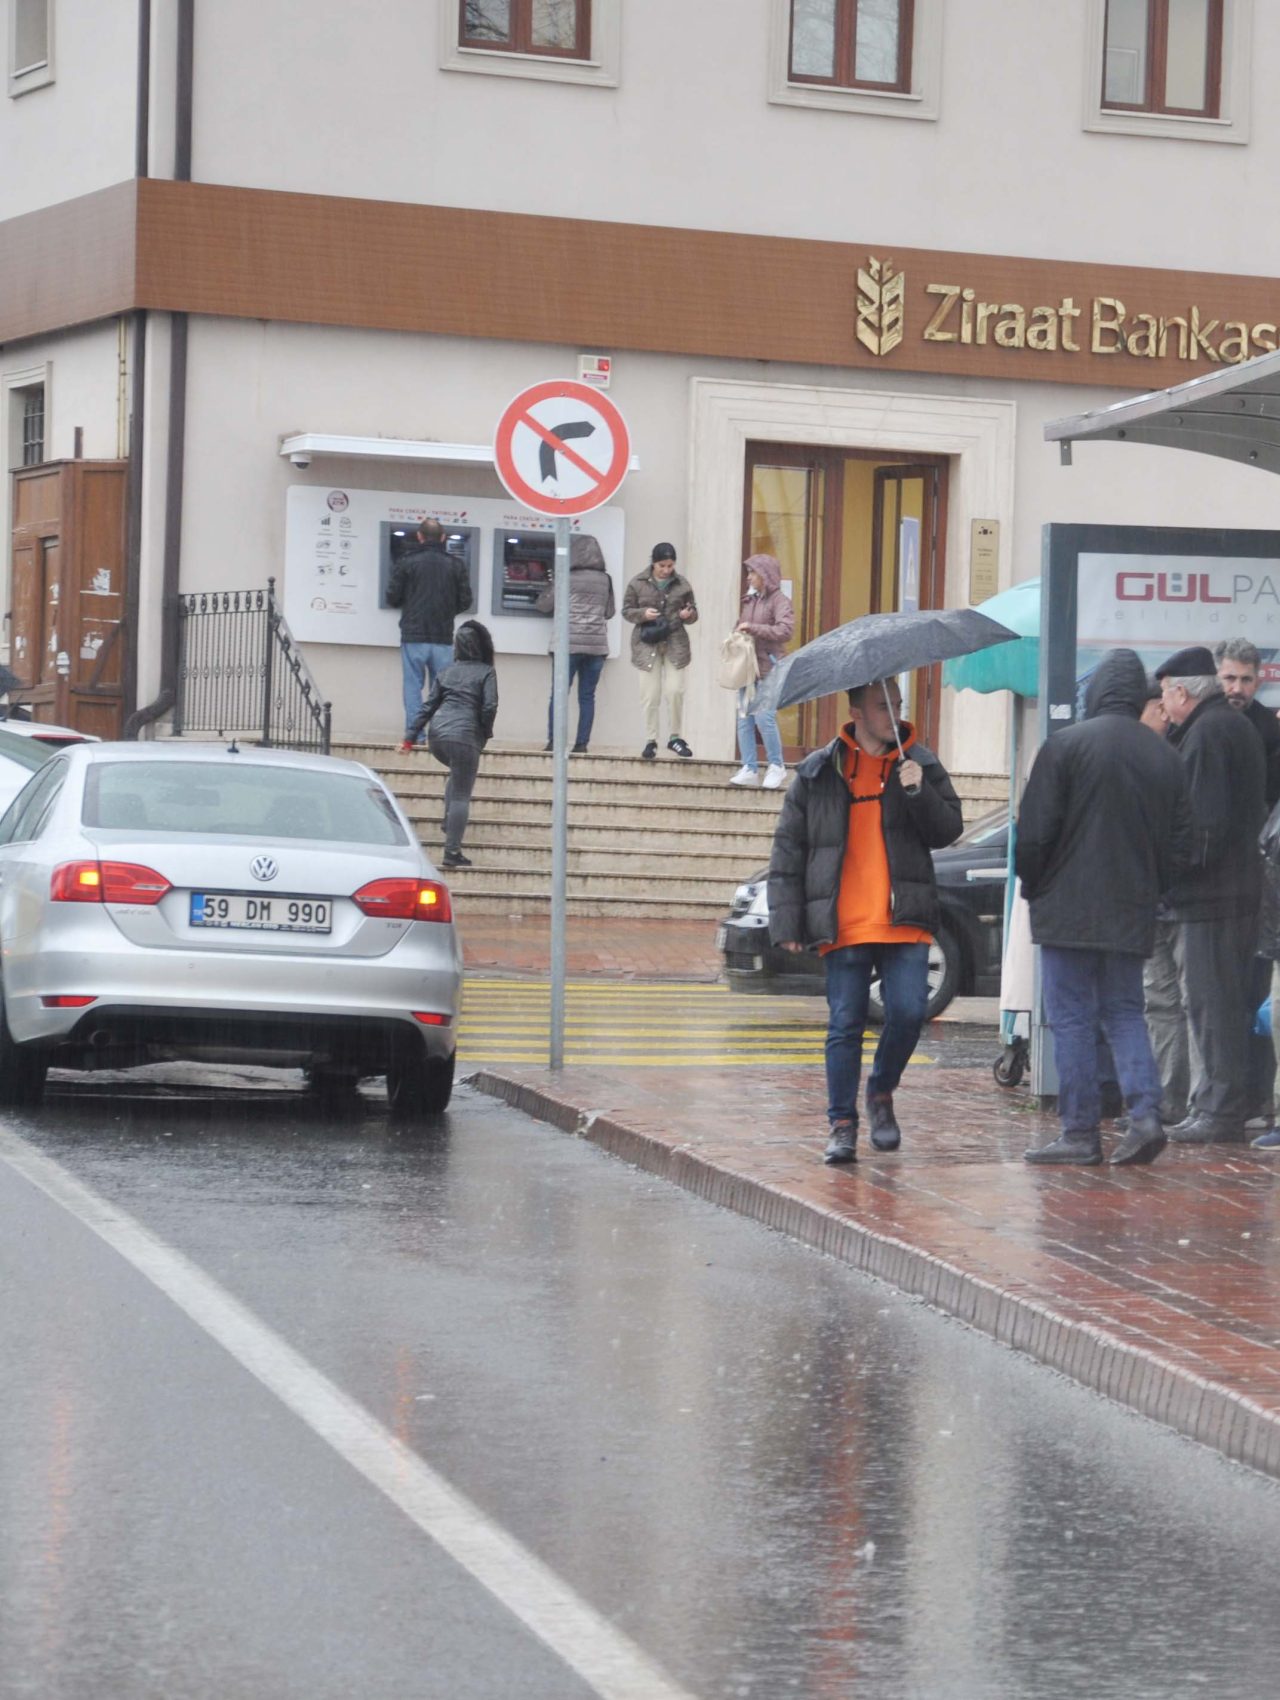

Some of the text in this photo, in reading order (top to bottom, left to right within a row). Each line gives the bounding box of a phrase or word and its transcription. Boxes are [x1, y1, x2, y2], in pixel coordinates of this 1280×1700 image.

[923, 283, 1081, 352] Ziraat
[203, 897, 229, 919] 59
[246, 899, 271, 921] DM
[288, 901, 327, 924] 990
